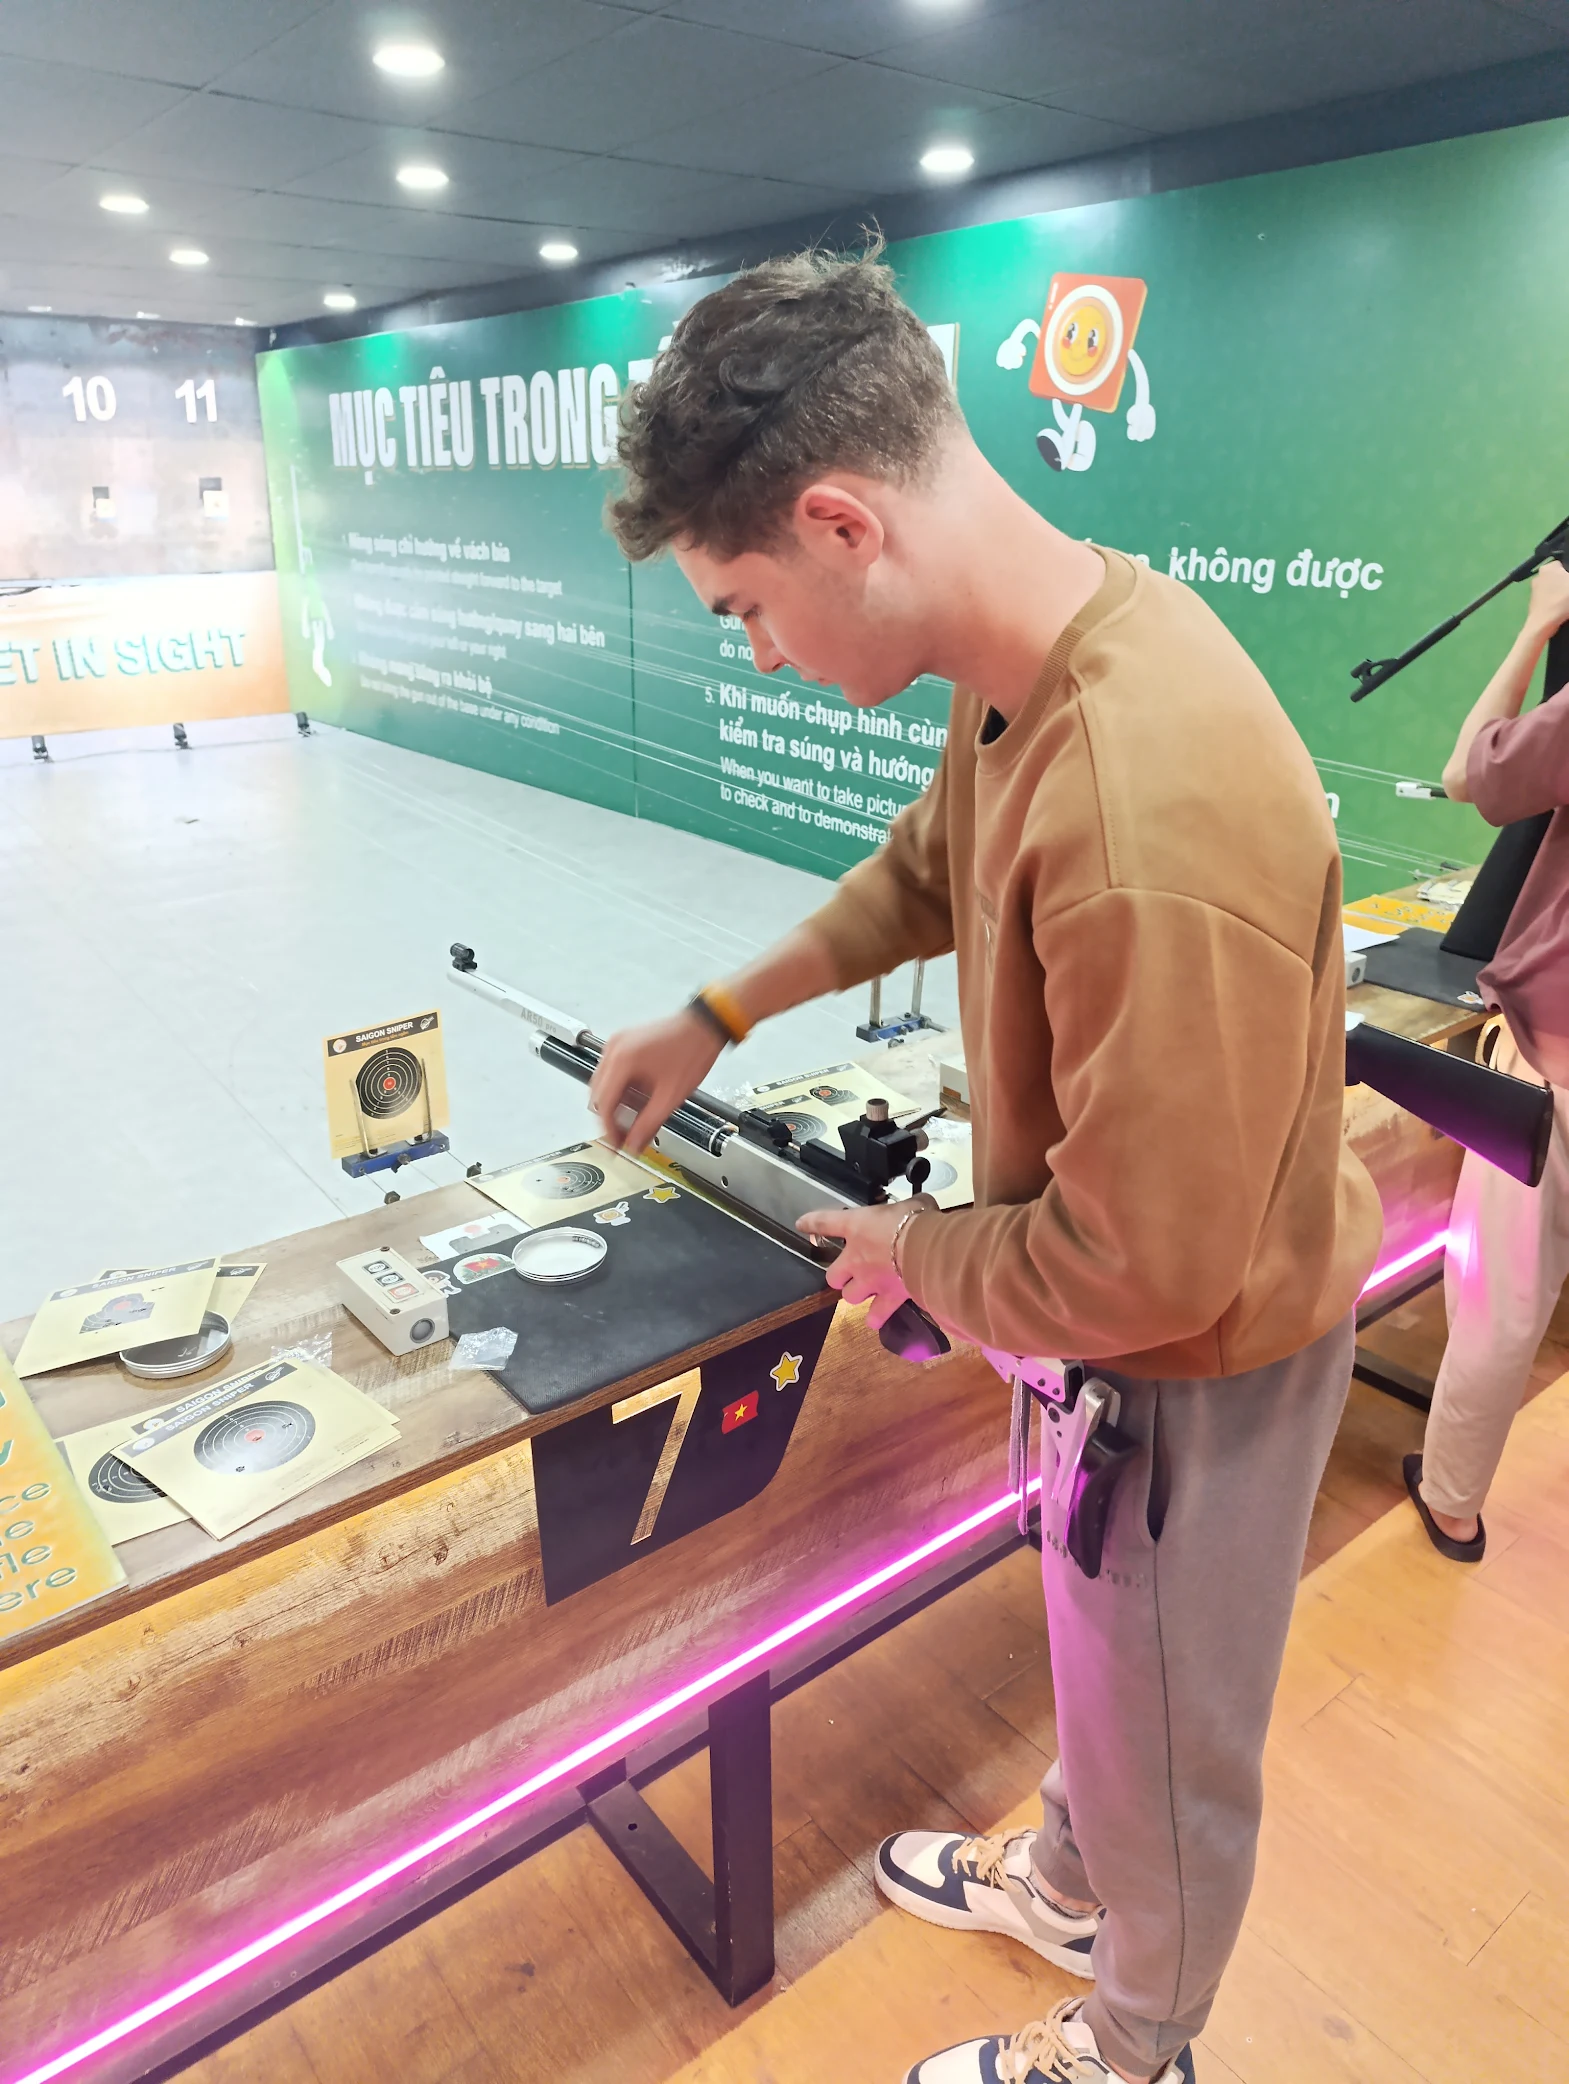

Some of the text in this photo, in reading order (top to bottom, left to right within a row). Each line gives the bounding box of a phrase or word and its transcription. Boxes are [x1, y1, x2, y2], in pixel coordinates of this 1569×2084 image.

[63, 375, 117, 422] 10
[175, 379, 218, 423] 11
[329, 363, 619, 486] MỤC TIÊU TRONG
[1169, 546, 1276, 594] không
[1286, 548, 1384, 599] được
[53, 637, 107, 681] IN
[115, 630, 246, 676] SIGHT
[557, 620, 578, 644] hai
[580, 624, 606, 649] bên
[719, 639, 735, 658] do
[720, 683, 747, 710] Khi
[751, 691, 800, 721] muốn
[805, 700, 852, 736] chụp
[858, 707, 902, 741] hình
[720, 716, 935, 793] kiểm tra súng và hướng
[720, 756, 907, 818] When you want to take pictu
[720, 784, 731, 801] to
[734, 787, 769, 813] check
[772, 798, 796, 820] and
[799, 805, 811, 823] to
[355, 1029, 386, 1043] SAIGON
[386, 1021, 414, 1035] SNIPER
[521, 1007, 543, 1027] AR50
[92, 1267, 177, 1289] SAIGON SNIPER
[165, 1383, 255, 1432] SAIGON SNIPER
[175, 1388, 222, 1413] SAIGON
[611, 1366, 702, 1546] 7
